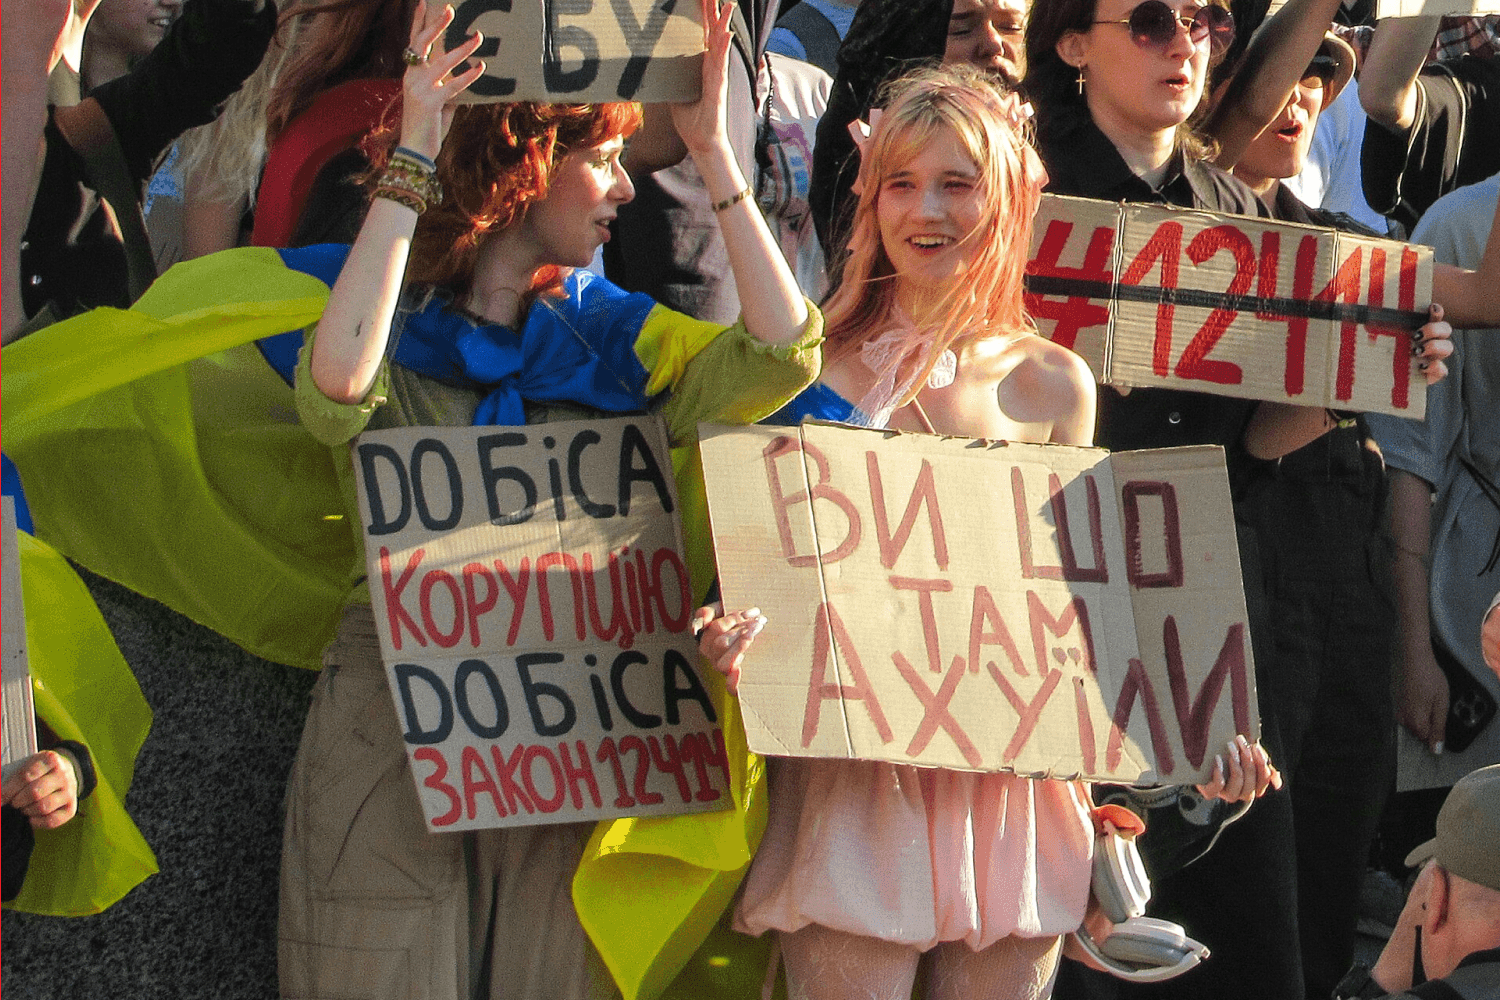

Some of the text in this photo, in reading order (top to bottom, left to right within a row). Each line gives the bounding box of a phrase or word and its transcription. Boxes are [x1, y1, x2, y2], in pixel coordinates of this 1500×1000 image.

[1023, 218, 1420, 410] #12414
[763, 435, 1184, 589] ВИ ШО
[888, 575, 1099, 678] ТАМ
[413, 738, 603, 828] ЗАКОН
